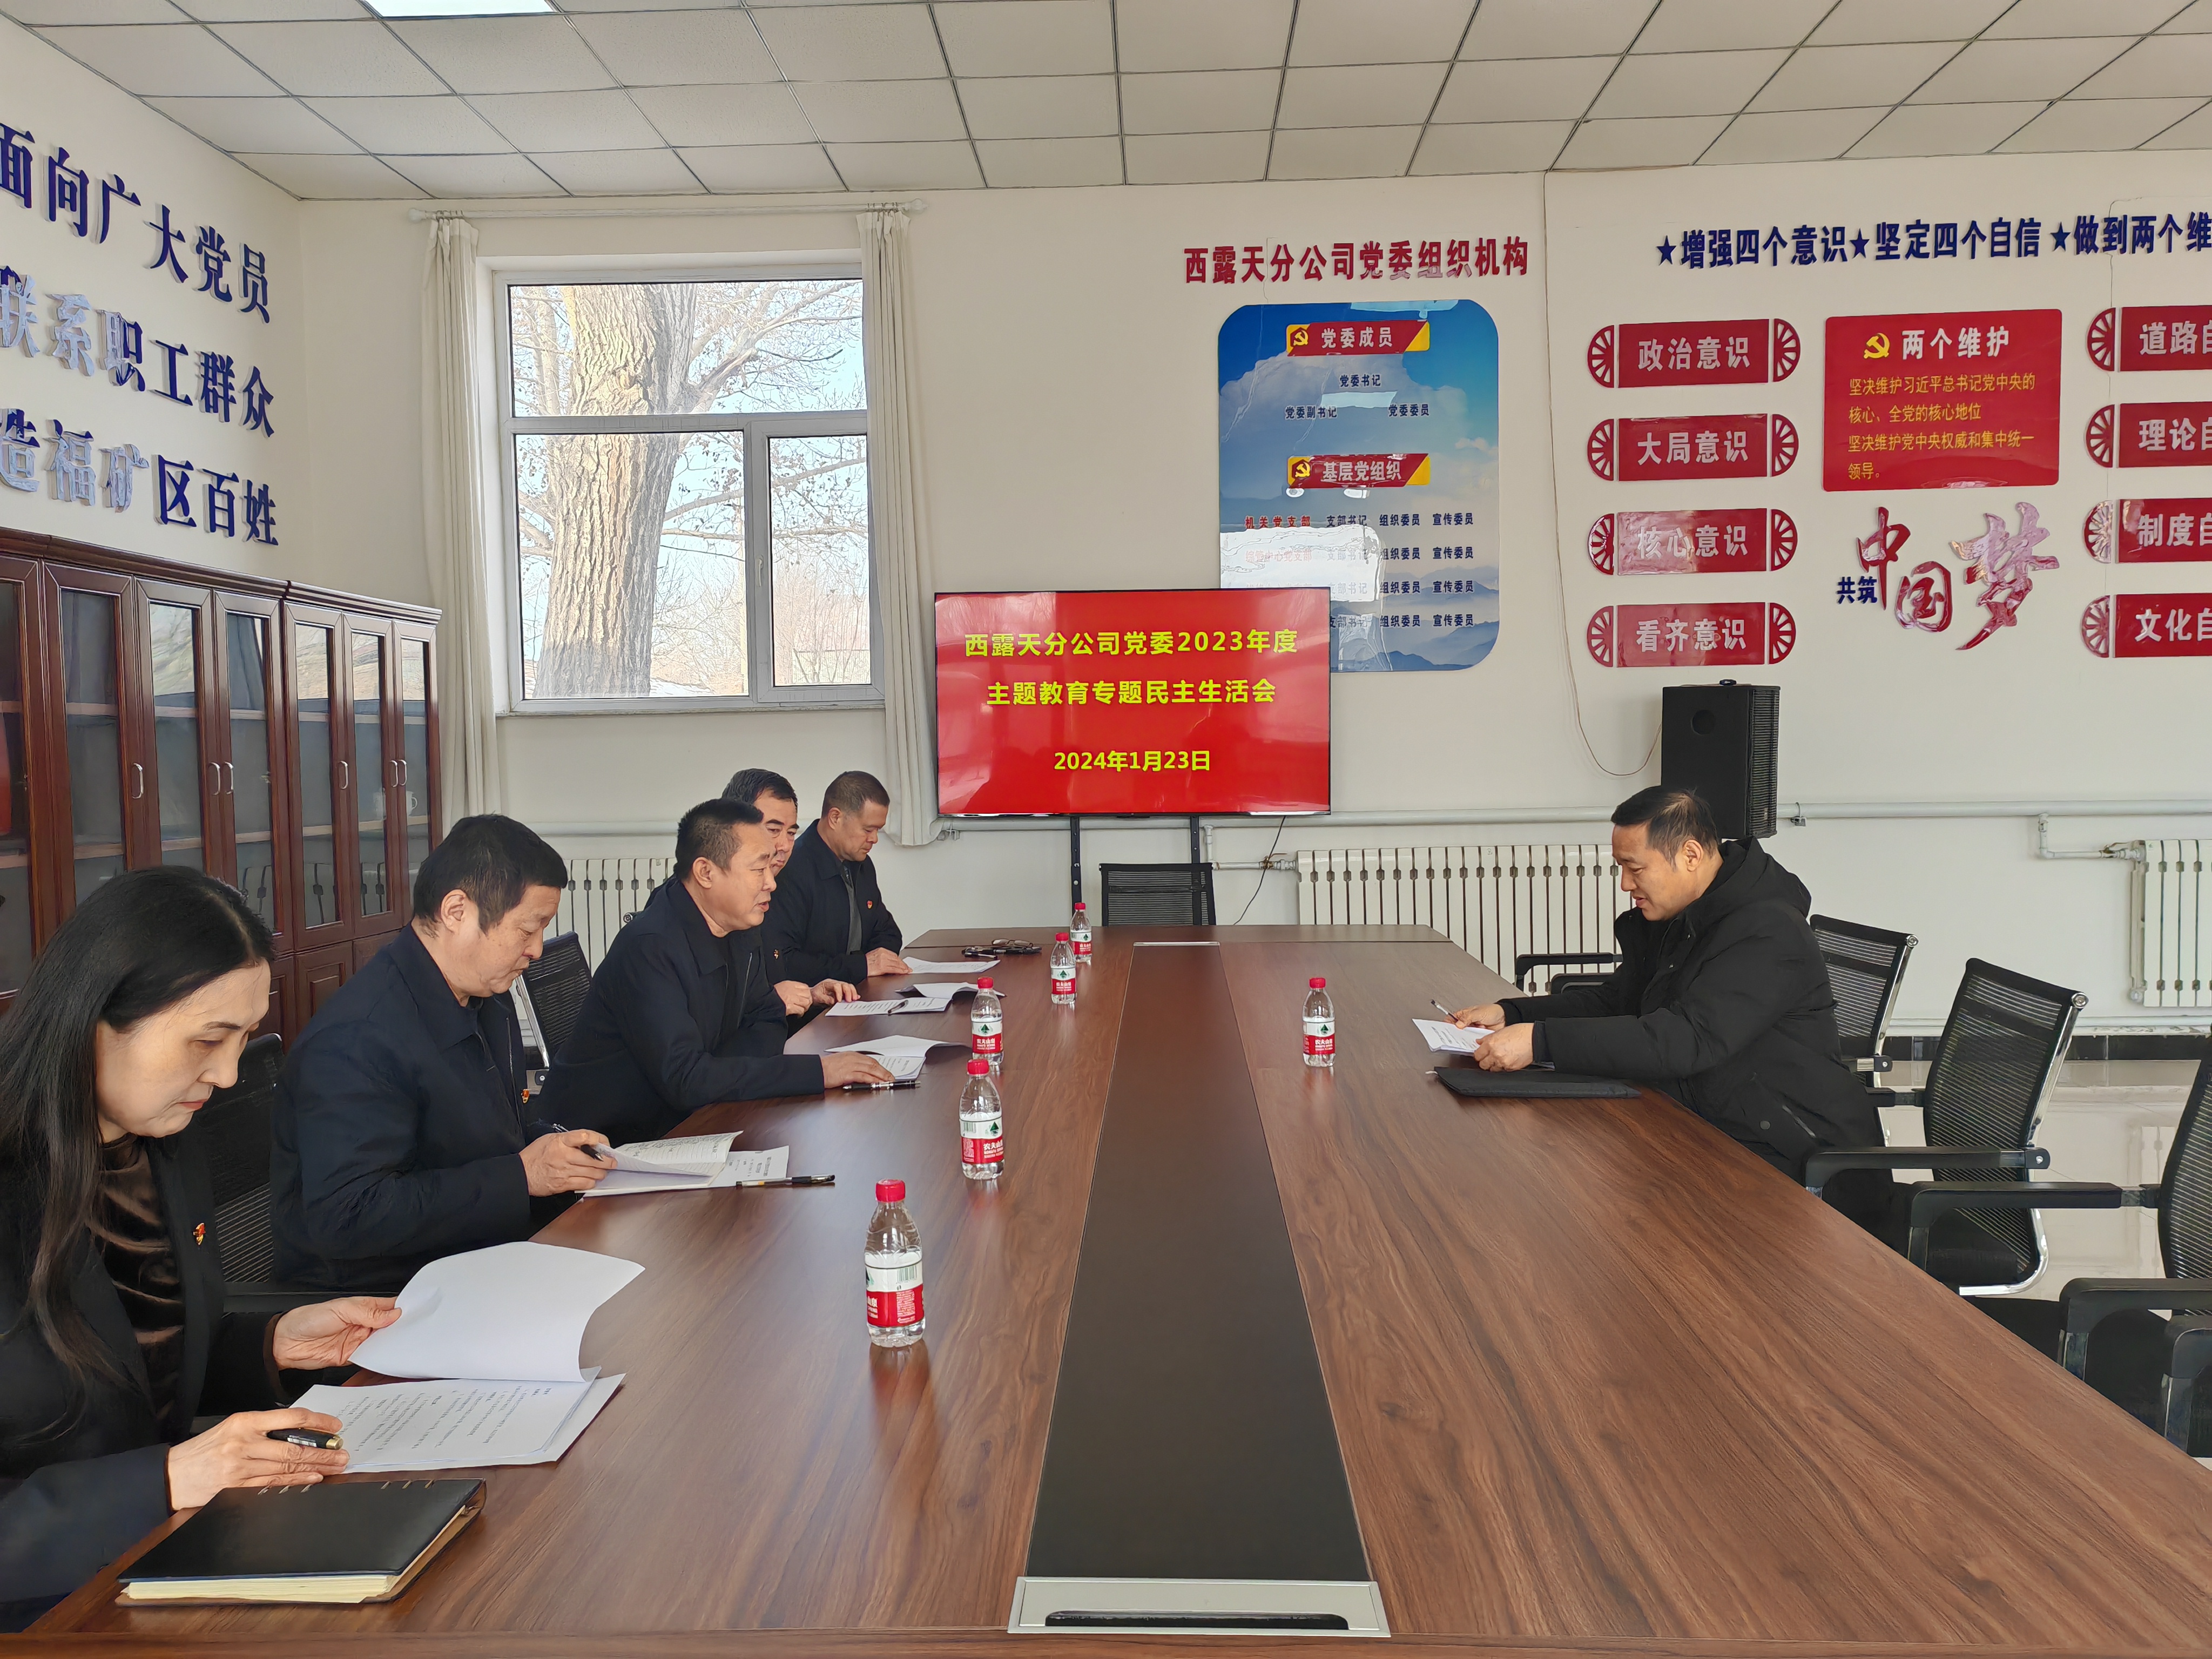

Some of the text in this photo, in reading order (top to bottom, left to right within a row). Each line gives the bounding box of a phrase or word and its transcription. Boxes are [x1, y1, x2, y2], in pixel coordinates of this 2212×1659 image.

[0, 122, 270, 323] 面向广大党员
[1681, 225, 1849, 269] 增强四个意识
[1875, 217, 2041, 260] 坚定四个自信
[1184, 236, 1528, 284] 西露天分公司党委组织机构
[1321, 327, 1393, 349] 党委成员
[1901, 326, 2010, 360] 两个维护
[1638, 336, 1750, 372] 政治意识
[1340, 374, 1381, 388] 党委书记
[1849, 372, 2035, 396] 坚决维护习近平总书记党中央的
[1285, 403, 1429, 419] 党委副书记 党委委员
[1849, 402, 1981, 424] 核心、全党的核心地位
[1637, 430, 1749, 465] 大局意识
[1848, 429, 2034, 453] 坚决维护党中央权威和集中统一
[0, 408, 279, 547] 造福矿区百姓
[1320, 461, 1402, 482] 基层党组织
[1244, 512, 1473, 529] 机关党支部 支部书记 组织委员 宣传委员
[1380, 547, 1421, 560] 组织委员
[1432, 547, 1473, 559] 宣传委员
[1637, 524, 1749, 558] 核心意识
[1380, 581, 1421, 594] 组织委员
[1432, 580, 1473, 593] 宣传委员
[1836, 576, 1878, 604] 共筑
[1856, 502, 2060, 651] 中国梦
[1380, 615, 1421, 628] 组织委员
[1433, 614, 1474, 626] 宣传委员
[965, 629, 1298, 657] 西露天分公司党委2023年度
[1636, 618, 1746, 652] 看齐意识
[987, 679, 1276, 706] 主题教育专题民主生活会
[1054, 750, 1211, 772] 2024年1月23日
